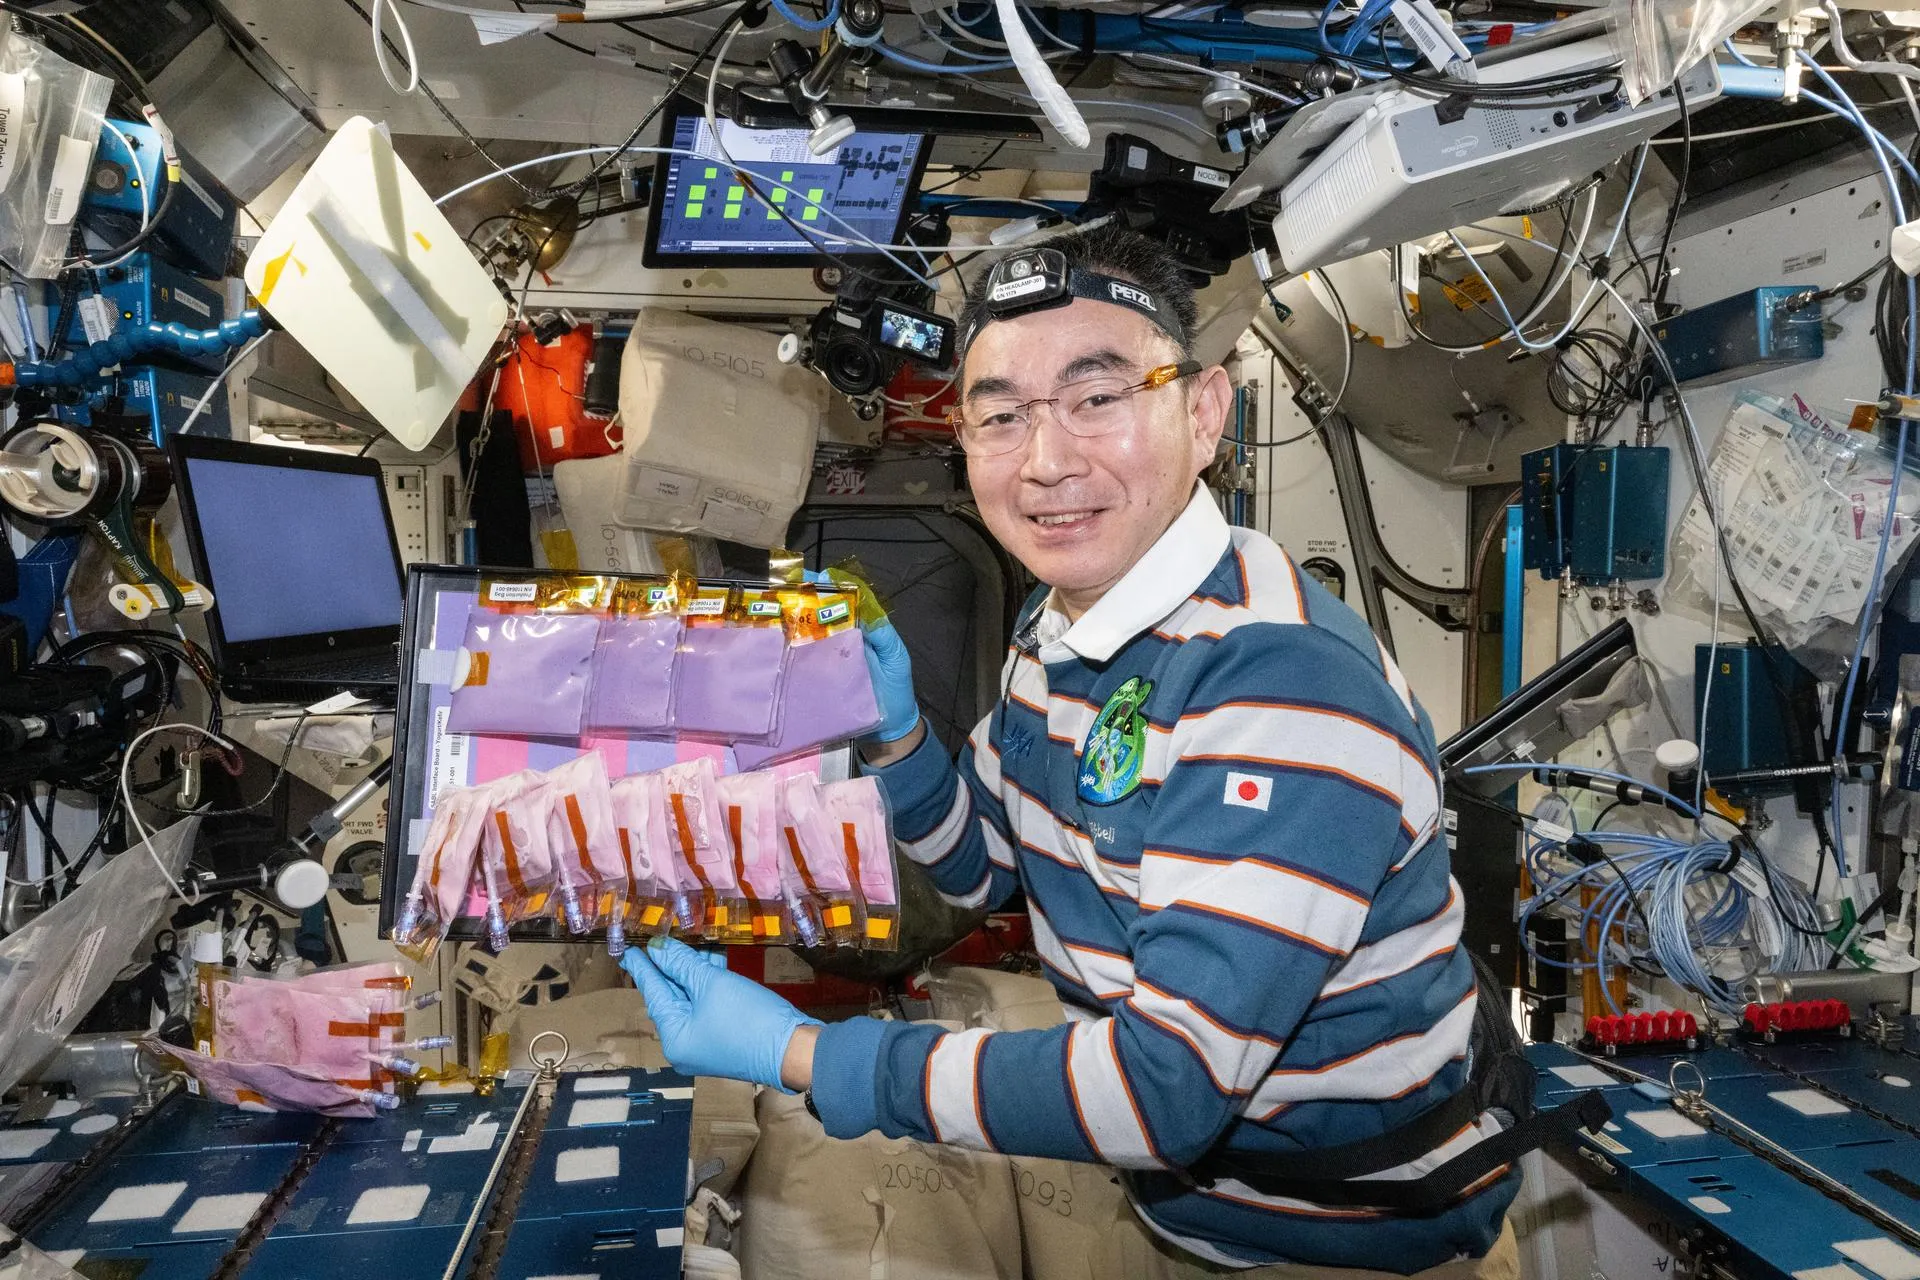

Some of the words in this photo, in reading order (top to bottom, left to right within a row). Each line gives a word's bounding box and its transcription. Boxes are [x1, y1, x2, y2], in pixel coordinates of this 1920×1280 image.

[1111, 283, 1157, 311] PETZL
[833, 470, 864, 488] EXIT
[96, 519, 122, 550] KAPTON
[431, 766, 440, 792] Interface
[350, 828, 374, 836] VALVE
